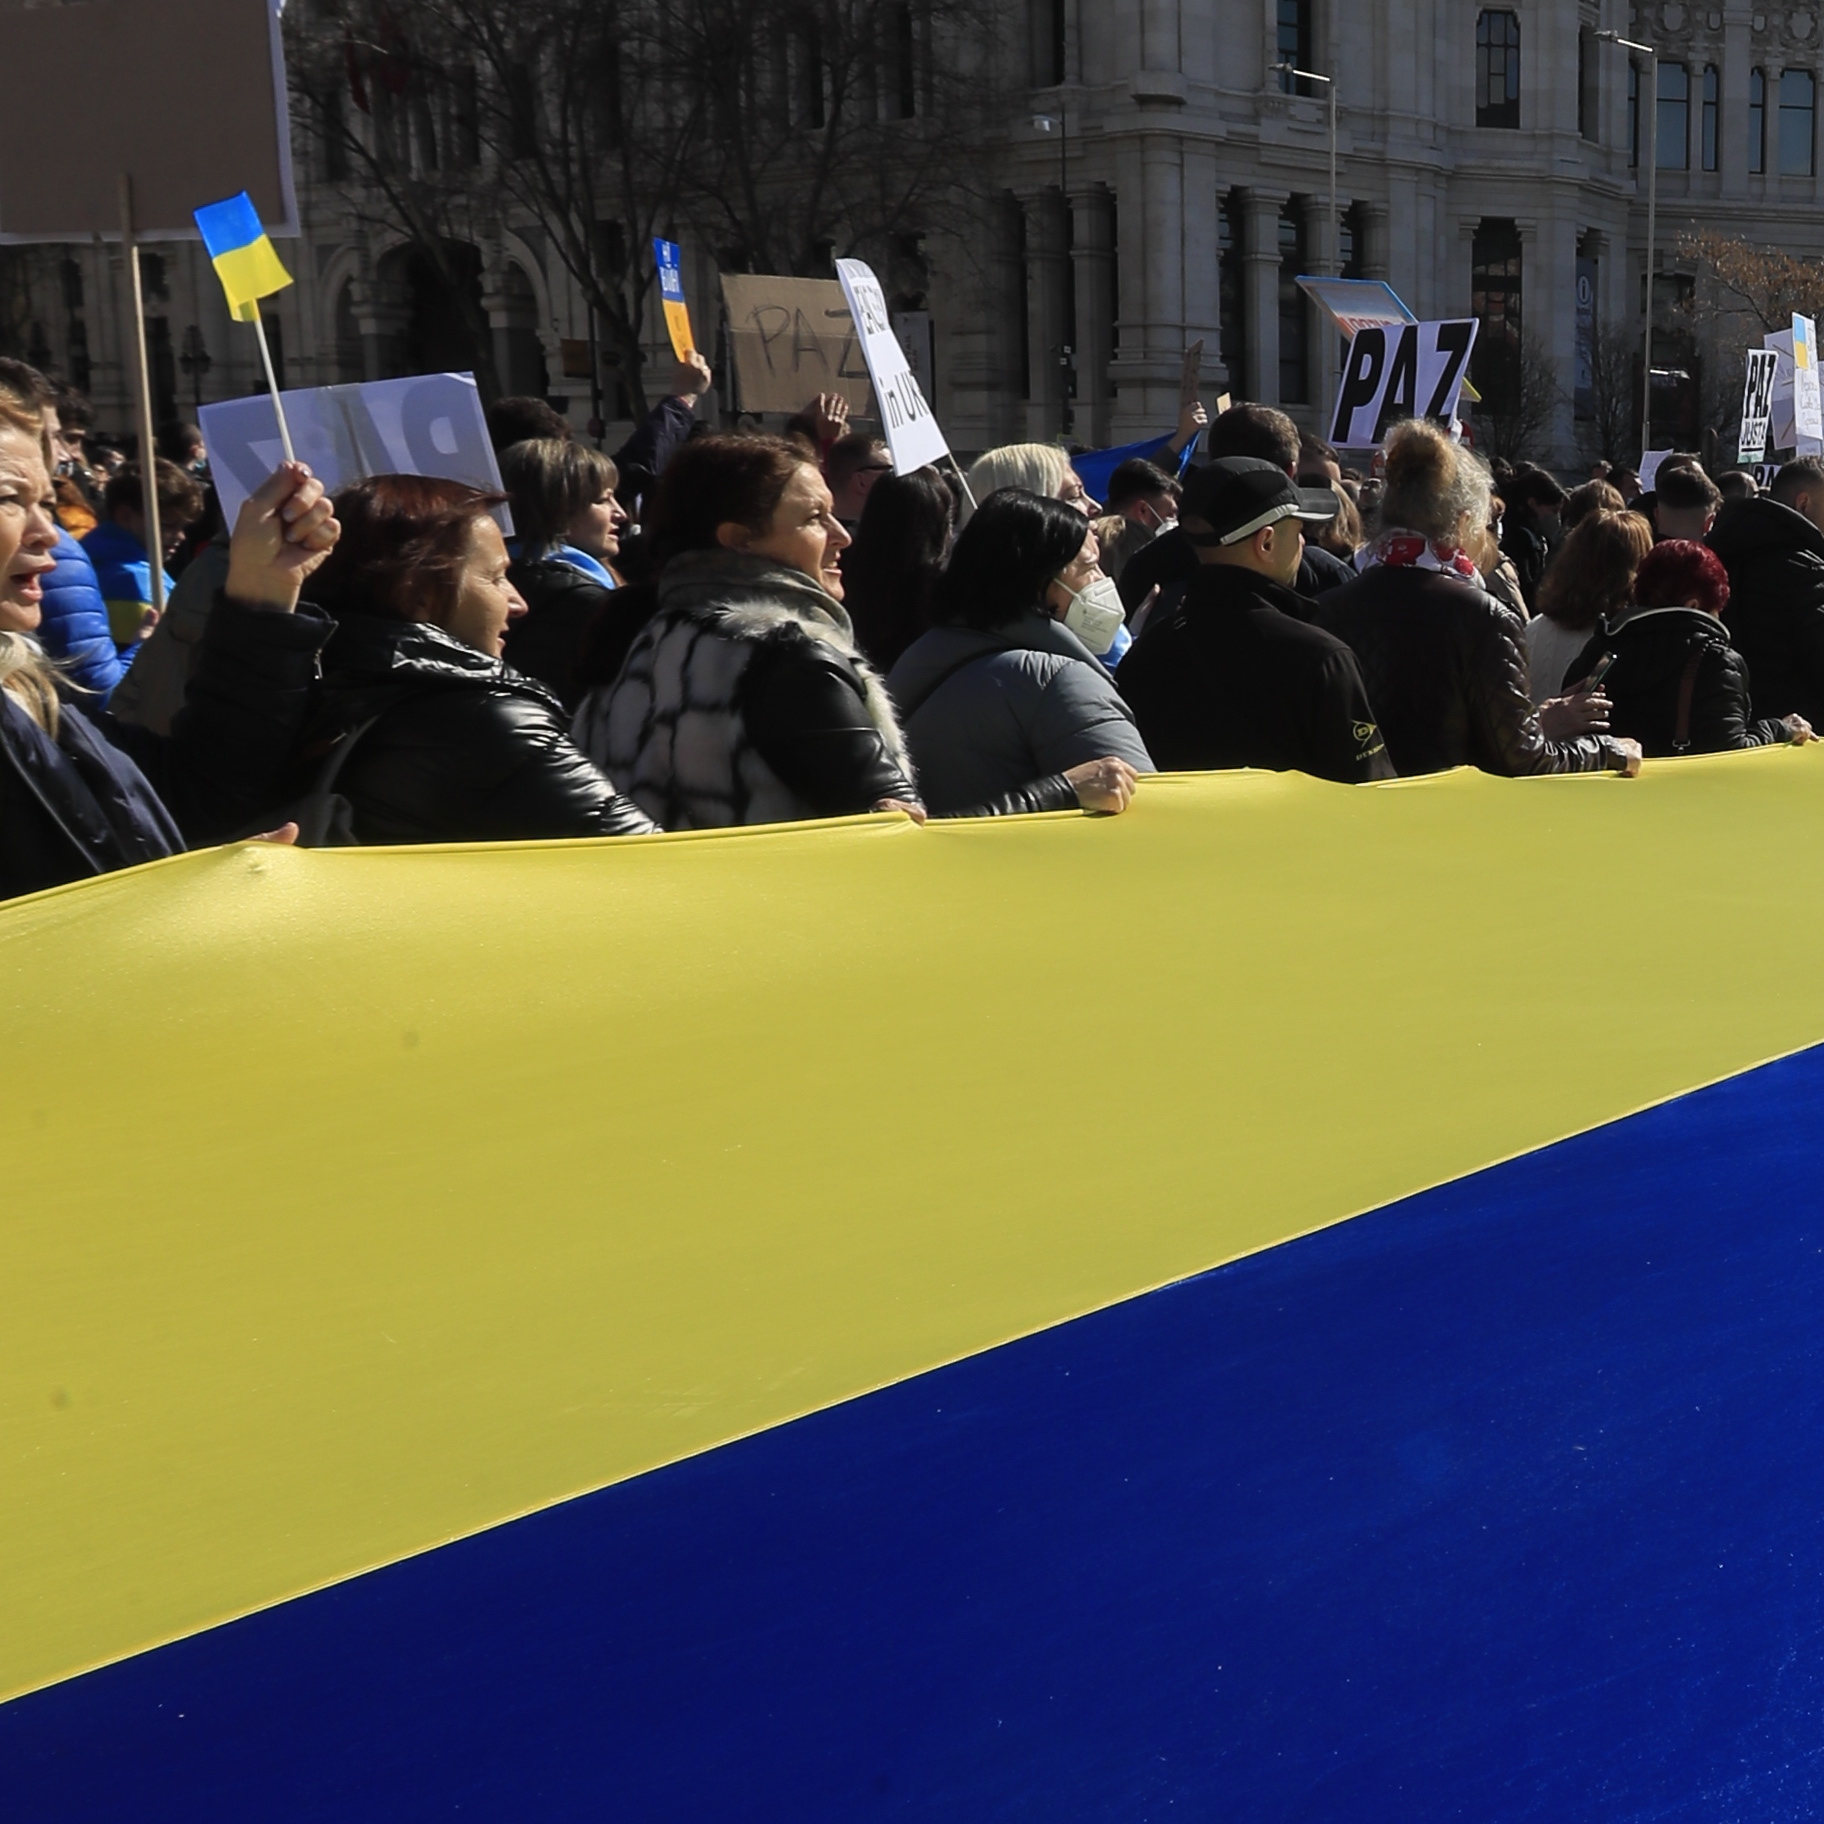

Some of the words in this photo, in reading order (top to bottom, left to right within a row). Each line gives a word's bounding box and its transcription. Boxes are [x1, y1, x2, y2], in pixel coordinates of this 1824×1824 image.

[746, 303, 870, 378] PAZ
[1331, 322, 1472, 443] PAZ
[1744, 354, 1776, 418] PAZ
